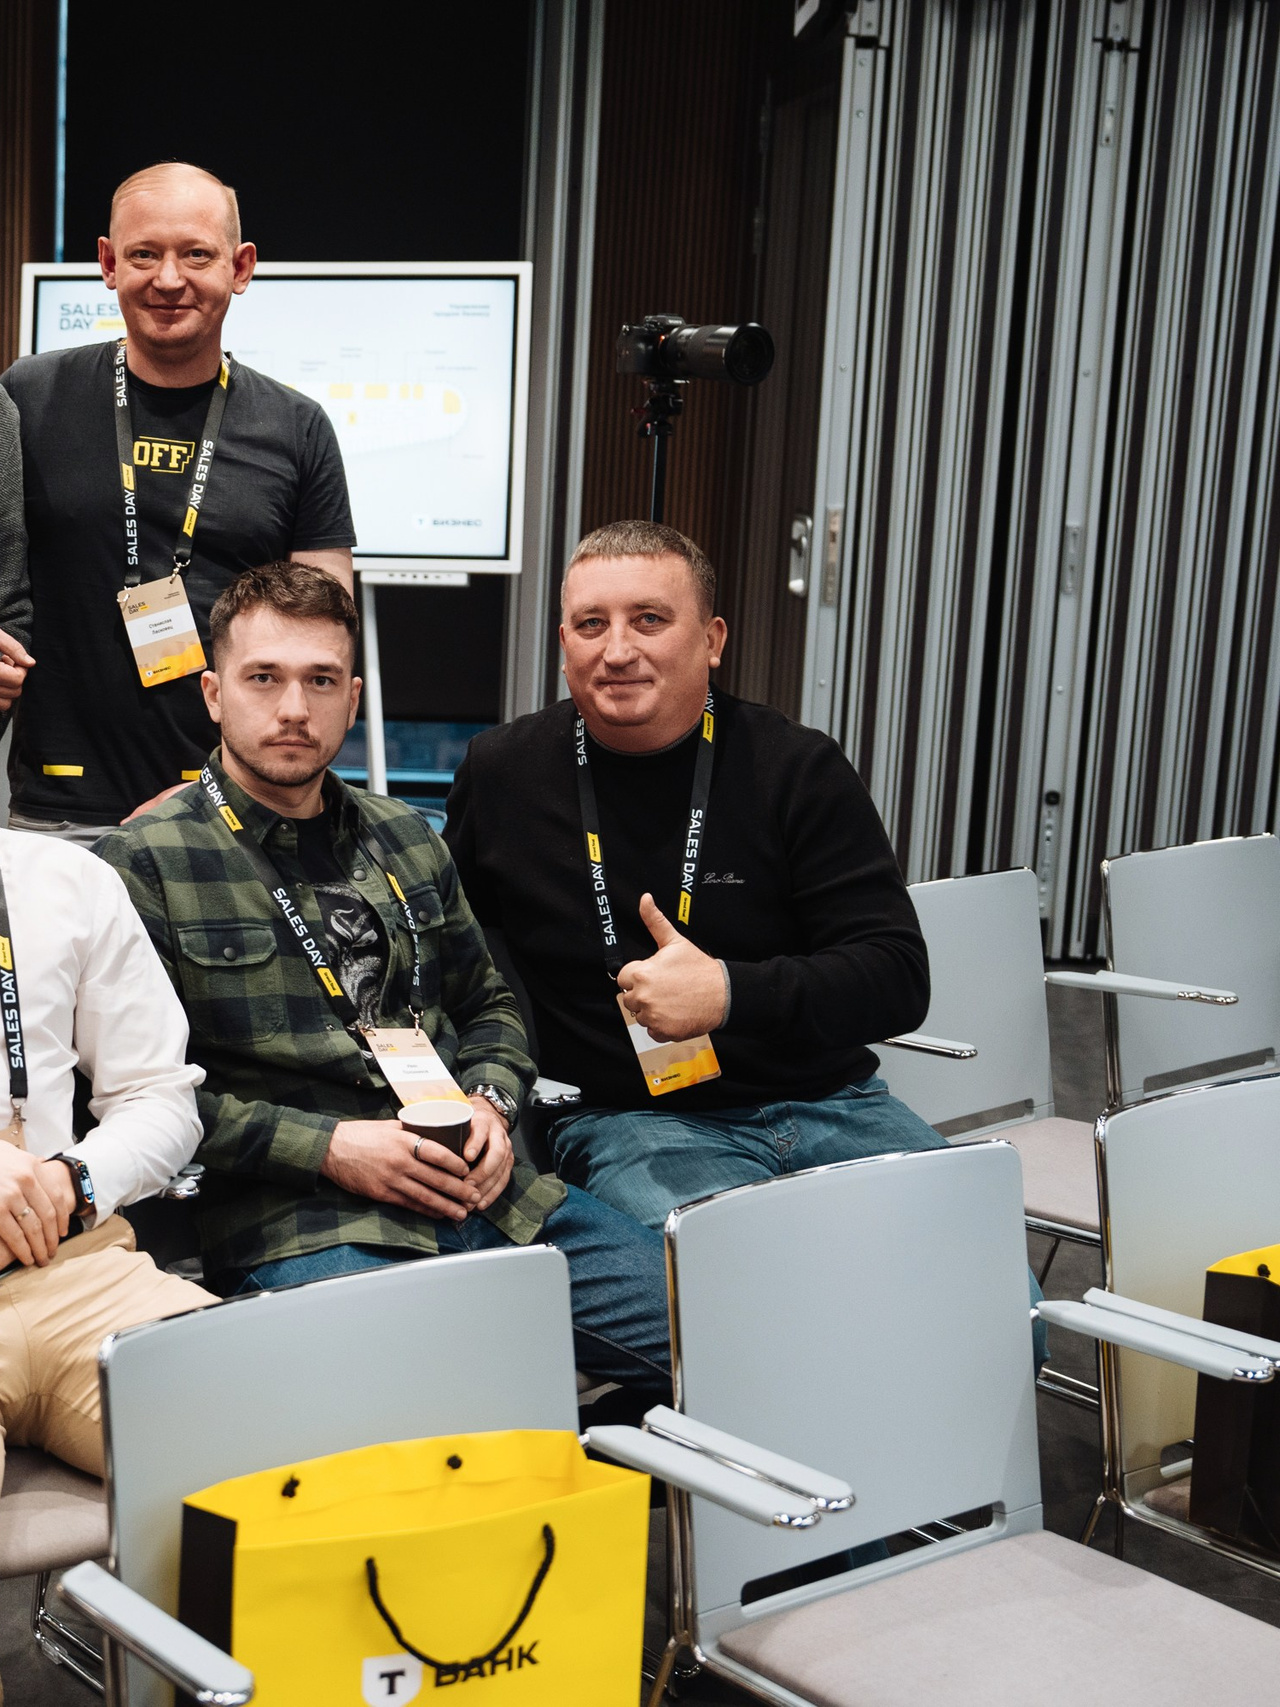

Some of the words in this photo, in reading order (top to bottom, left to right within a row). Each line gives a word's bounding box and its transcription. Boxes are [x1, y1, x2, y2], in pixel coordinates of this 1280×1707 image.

[59, 317, 93, 330] DAY
[60, 303, 119, 316] SALES
[115, 366, 128, 407] SALES
[133, 441, 188, 468] OFF
[195, 439, 214, 482] SALES
[125, 489, 136, 516] DAY
[190, 483, 203, 510] DAY
[125, 519, 139, 566] SALES
[127, 601, 146, 610] SALES
[576, 718, 588, 766] SALES
[206, 782, 227, 807] DAY
[685, 808, 703, 859] SALES
[591, 862, 606, 892] DAY
[681, 862, 696, 893] DAY
[272, 887, 310, 944] SALES
[302, 938, 327, 969] DAY
[401, 901, 416, 930] DAY
[597, 894, 617, 946] SALES
[0, 969, 17, 1004] DAY
[5, 1008, 24, 1069] SALES
